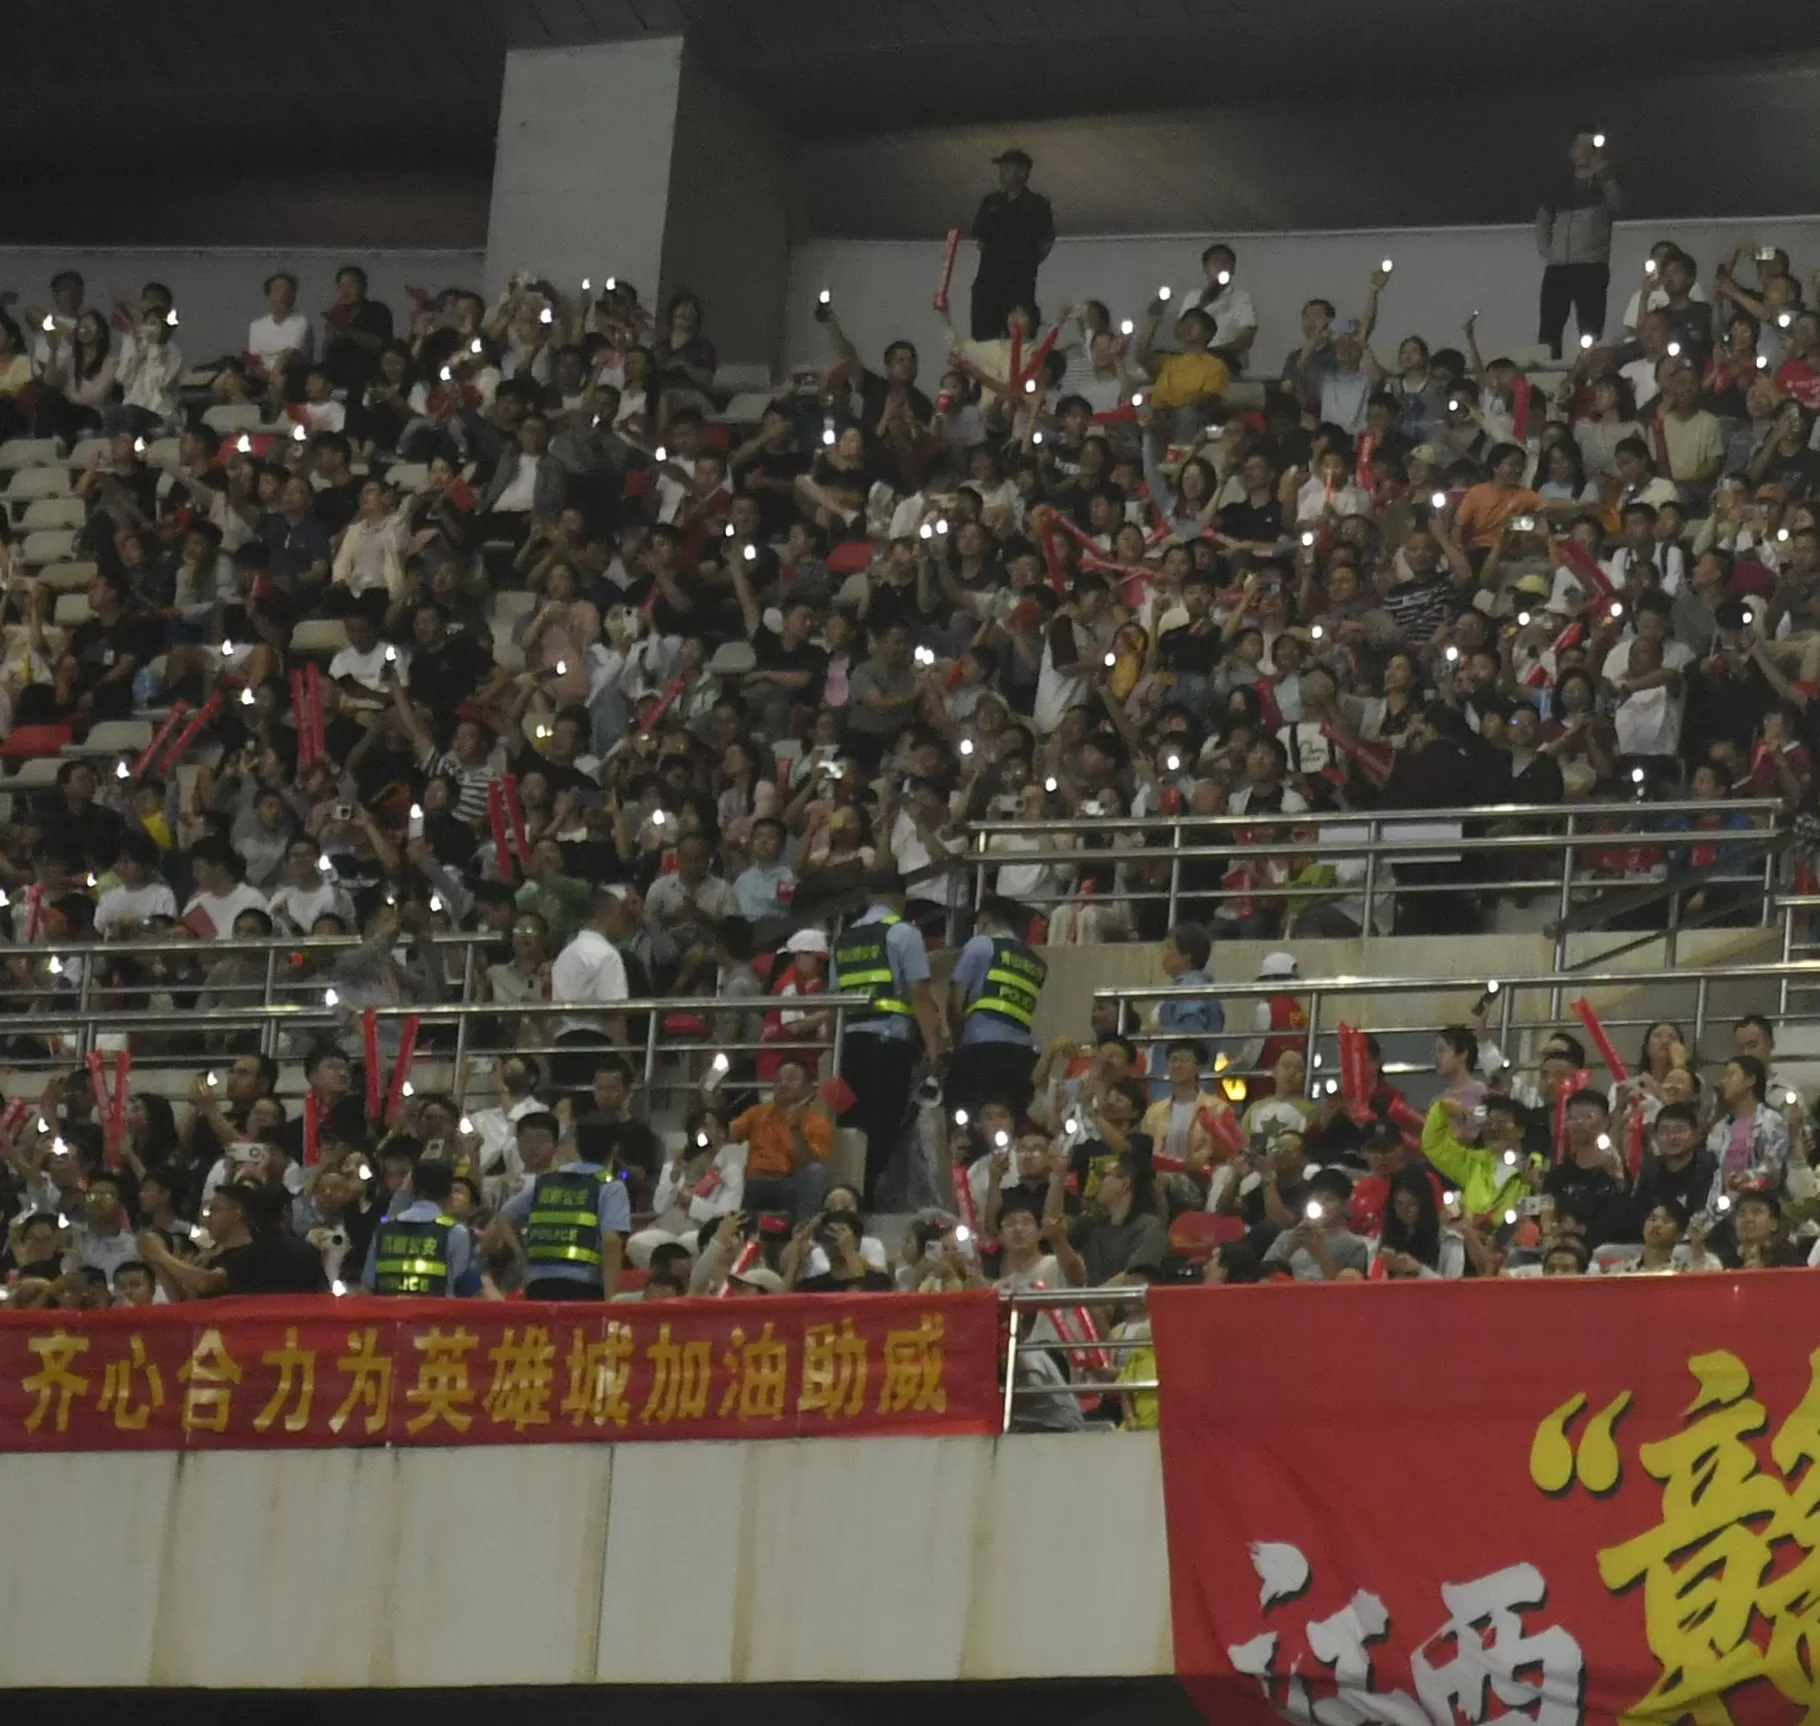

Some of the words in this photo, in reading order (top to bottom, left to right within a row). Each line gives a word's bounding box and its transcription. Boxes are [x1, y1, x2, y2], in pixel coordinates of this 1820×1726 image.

[21, 1313, 947, 1434] 齐心合力为英雄城加油助威
